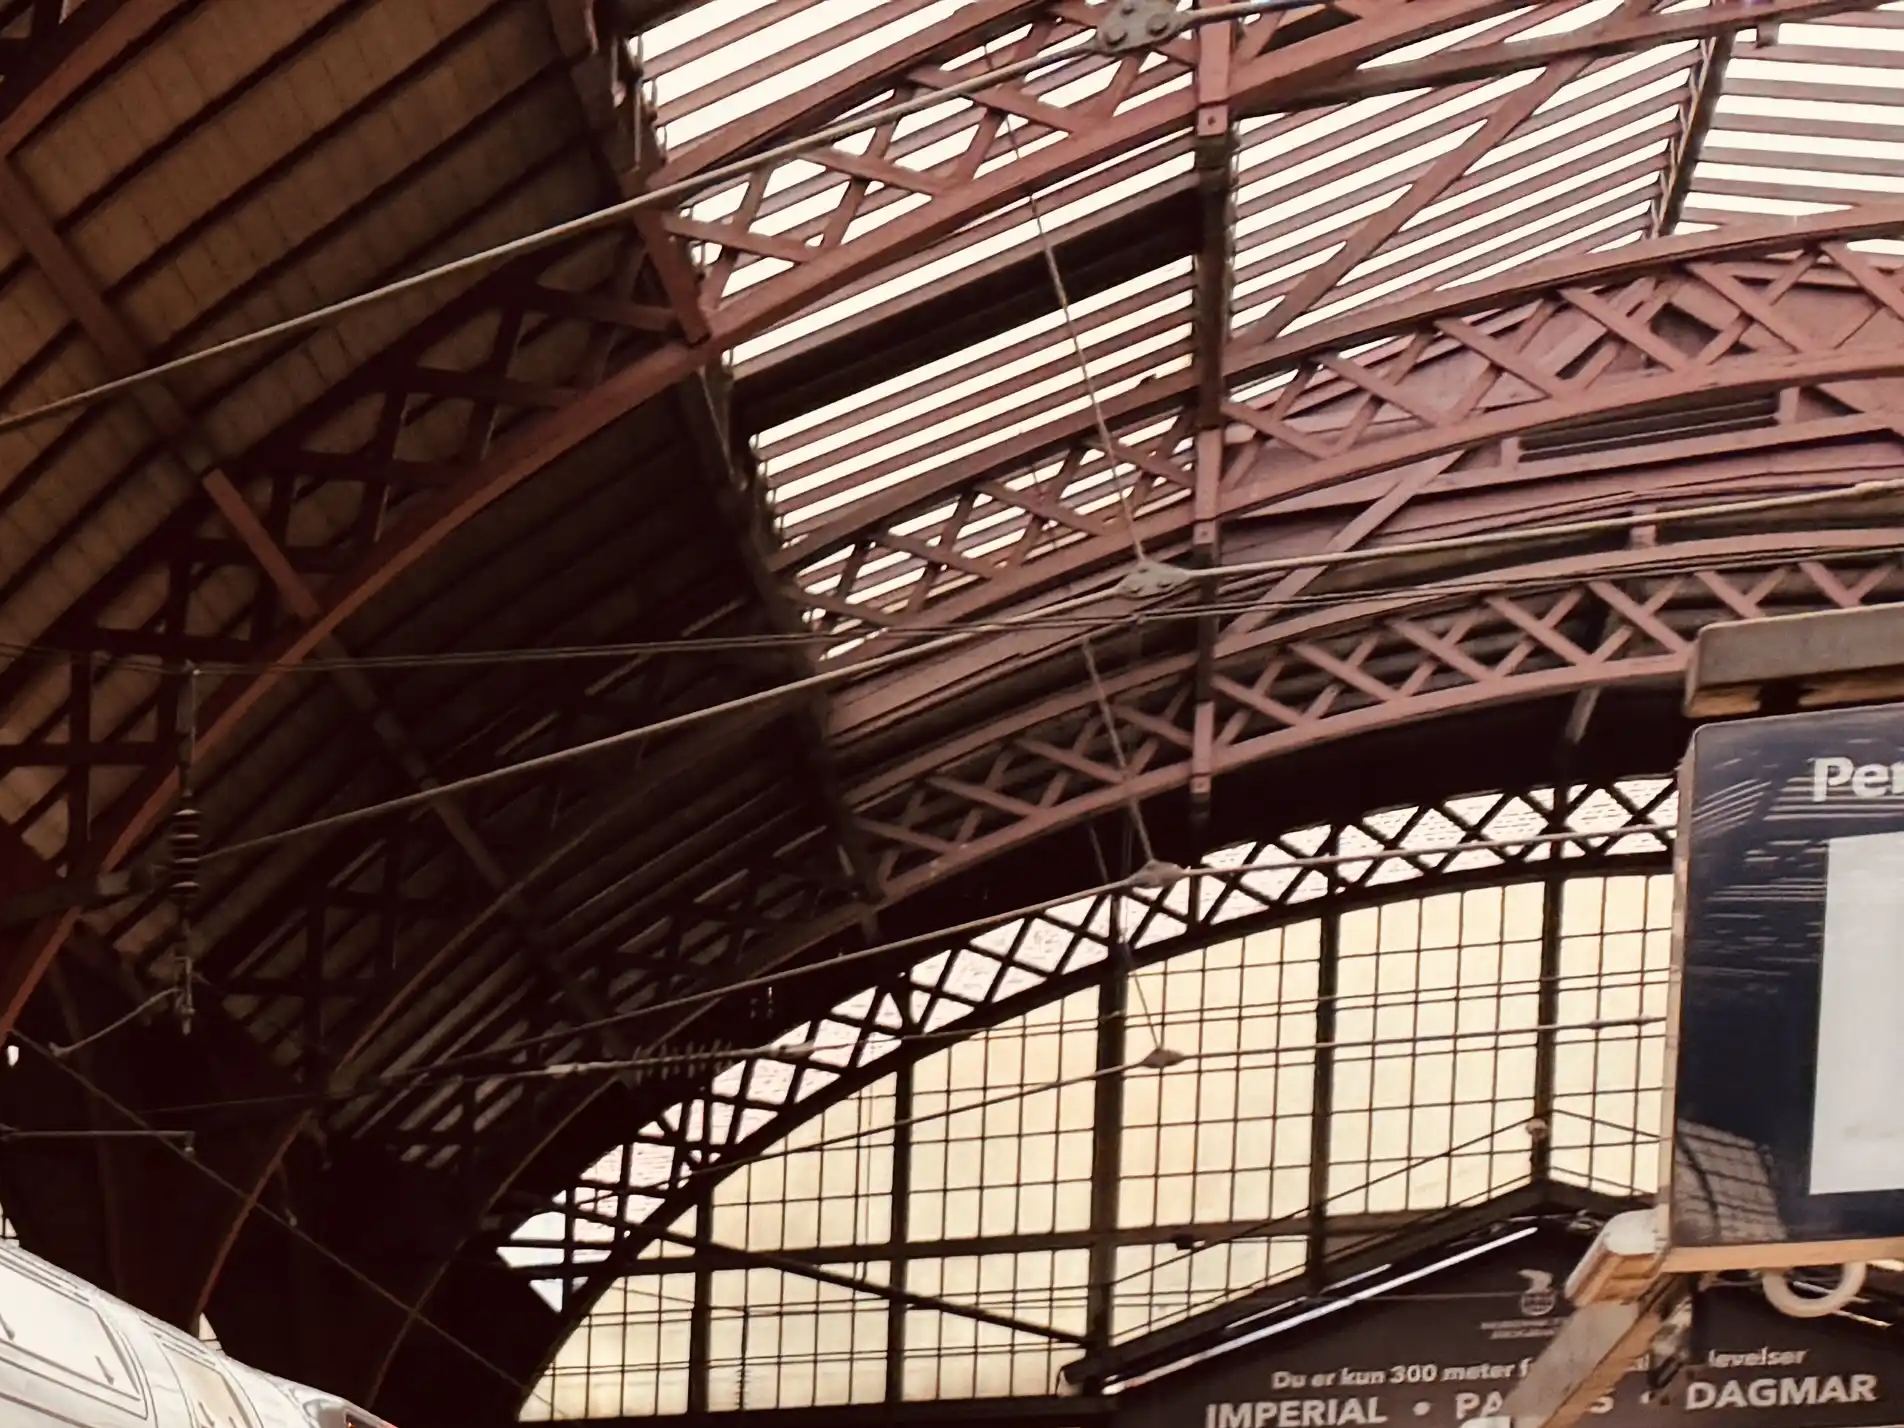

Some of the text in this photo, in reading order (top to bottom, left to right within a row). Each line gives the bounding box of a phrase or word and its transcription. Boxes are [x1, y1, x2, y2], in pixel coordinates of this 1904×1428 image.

[1708, 1346, 1808, 1368] levelser
[1272, 1370, 1305, 1391] Du
[1311, 1371, 1336, 1388] er
[1341, 1366, 1385, 1386] kun
[1389, 1363, 1437, 1384] 300
[1440, 1361, 1515, 1382] meter
[1685, 1374, 1878, 1411] DAGMAR
